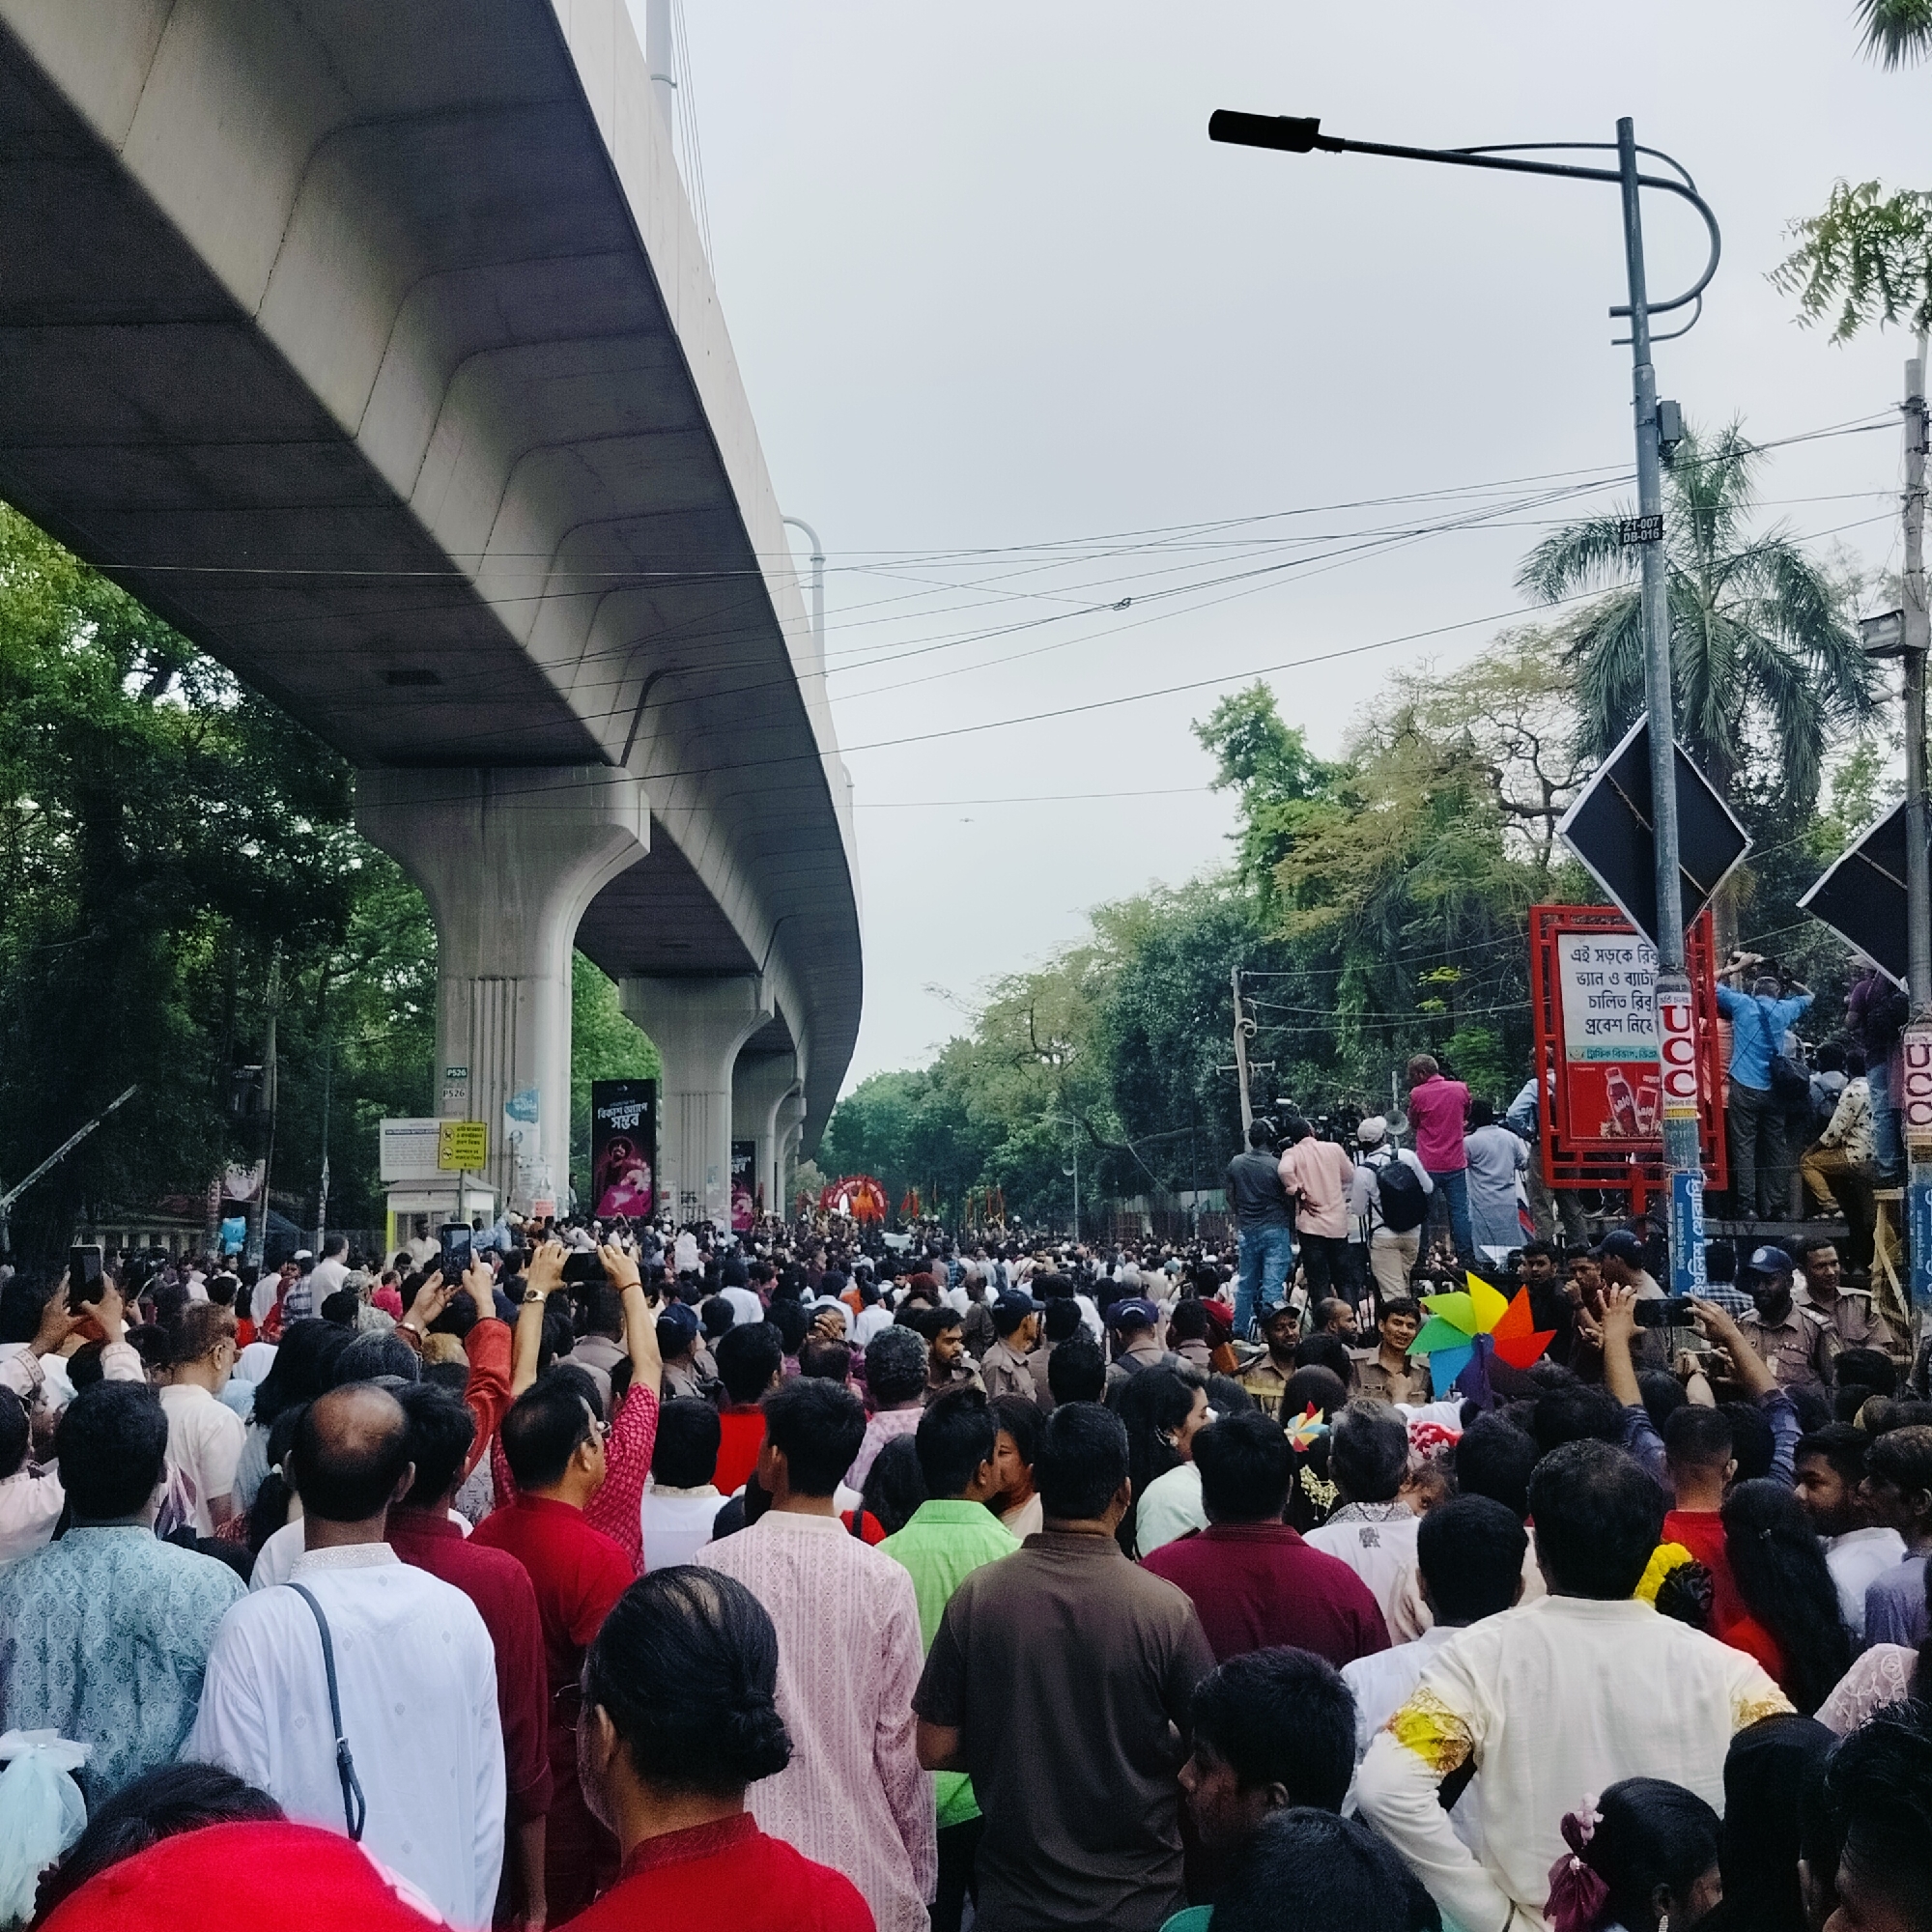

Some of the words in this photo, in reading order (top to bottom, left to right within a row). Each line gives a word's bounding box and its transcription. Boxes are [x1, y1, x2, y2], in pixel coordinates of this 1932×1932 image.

[1624, 517, 1660, 531] Z1-007
[1624, 528, 1660, 543] DB-016
[1571, 946, 1590, 963] এই
[1595, 949, 1633, 965] সড়কে
[1576, 972, 1604, 986] ভ্যান
[1608, 972, 1620, 985] ও
[1587, 990, 1627, 1009] চালিত
[1585, 1018, 1622, 1035] প্রবেশ
[1660, 1006, 1697, 1097] UCC
[447, 1068, 467, 1077] P526
[443, 1089, 465, 1098] P526
[611, 1113, 639, 1129] সম্ভব
[1686, 1178, 1704, 1236] থেরাপি
